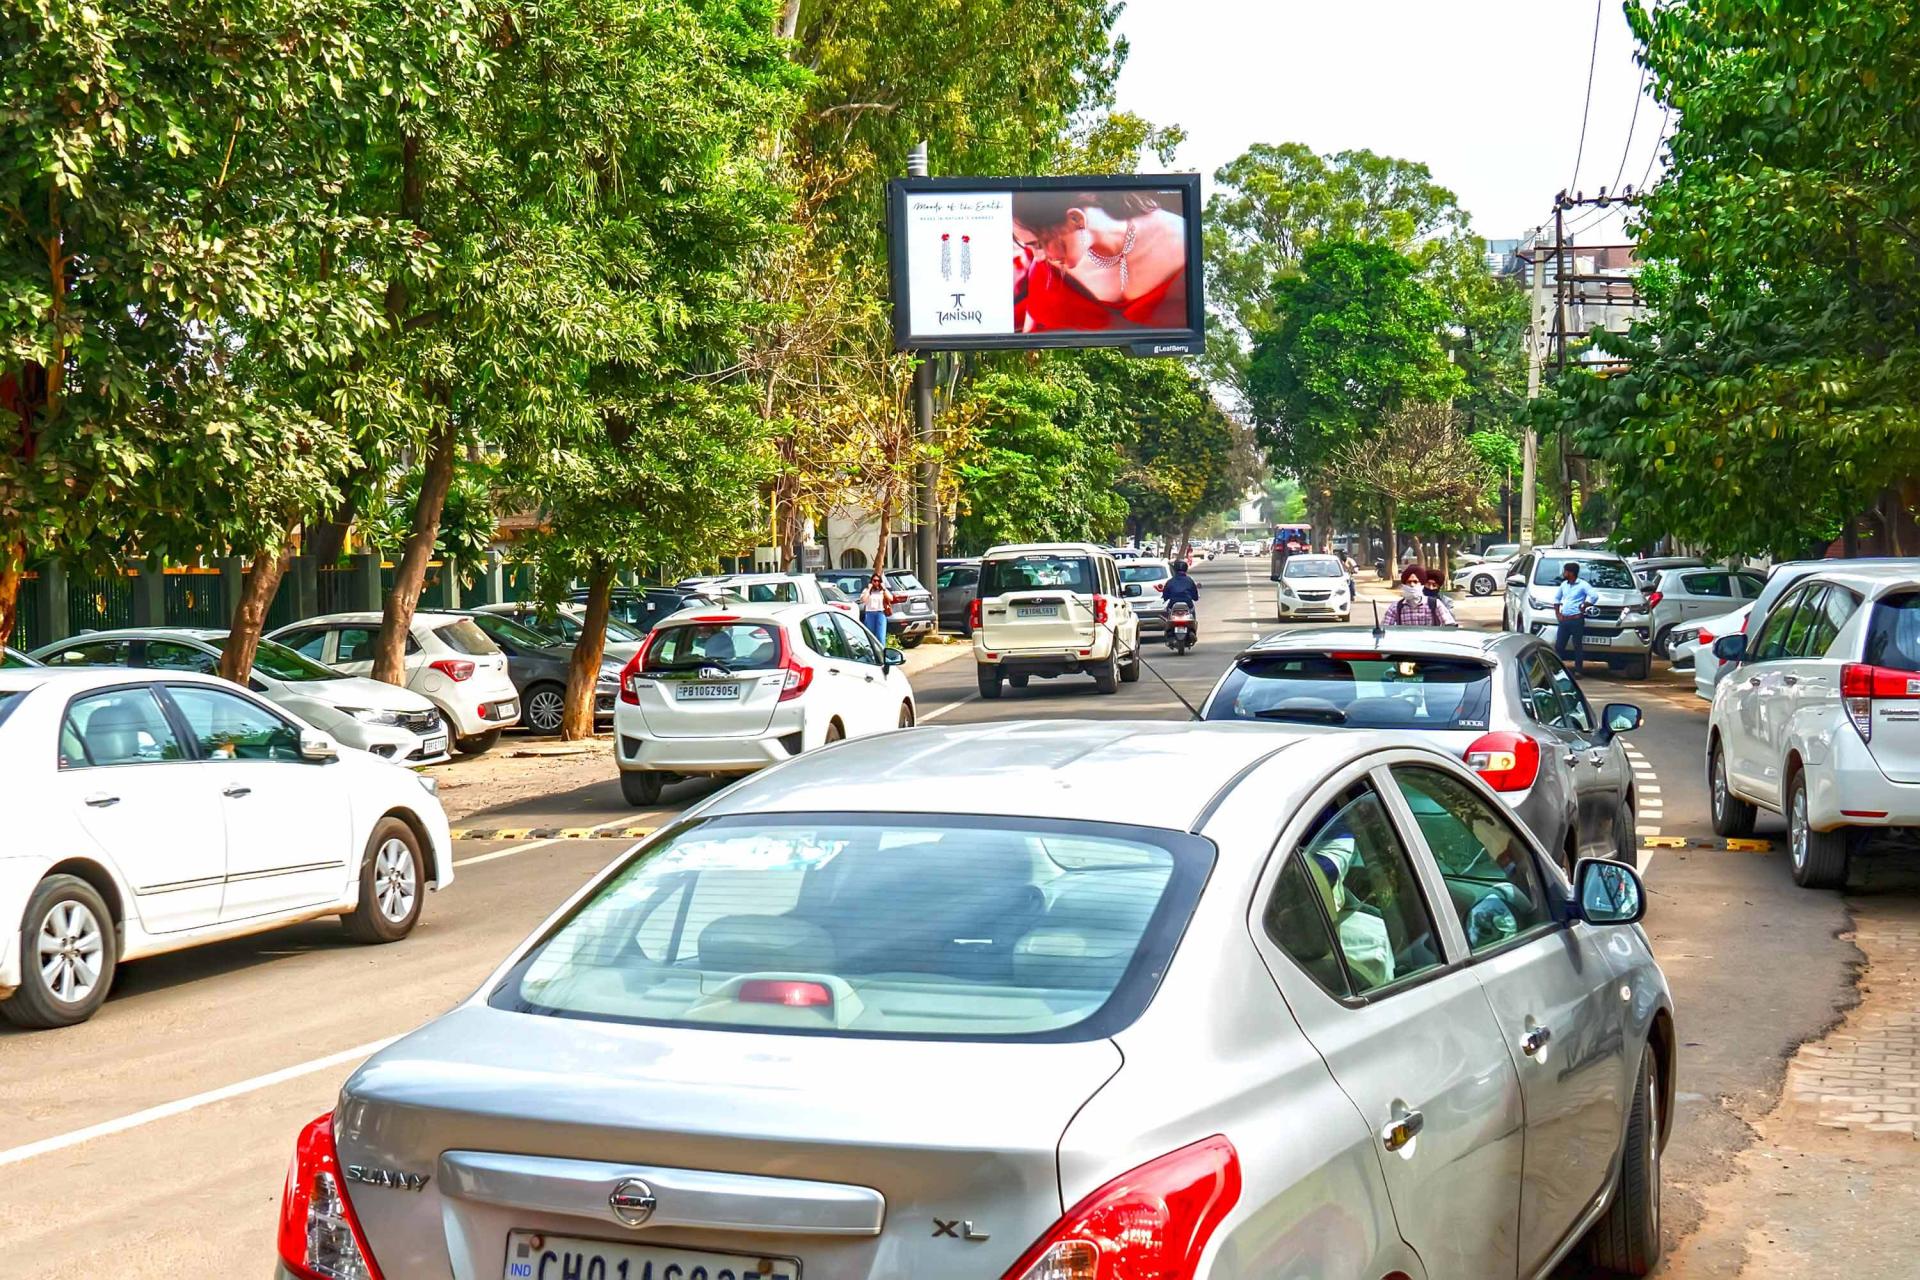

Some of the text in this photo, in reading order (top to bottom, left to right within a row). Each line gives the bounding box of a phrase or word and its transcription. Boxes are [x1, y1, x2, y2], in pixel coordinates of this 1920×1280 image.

[913, 202, 943, 212] Moods
[960, 202, 973, 211] the
[975, 200, 1004, 212] Earth
[682, 686, 738, 696] PB10GZ9054
[345, 1165, 431, 1192] SUNNY
[931, 1217, 990, 1241] XL
[511, 1263, 532, 1277] IND
